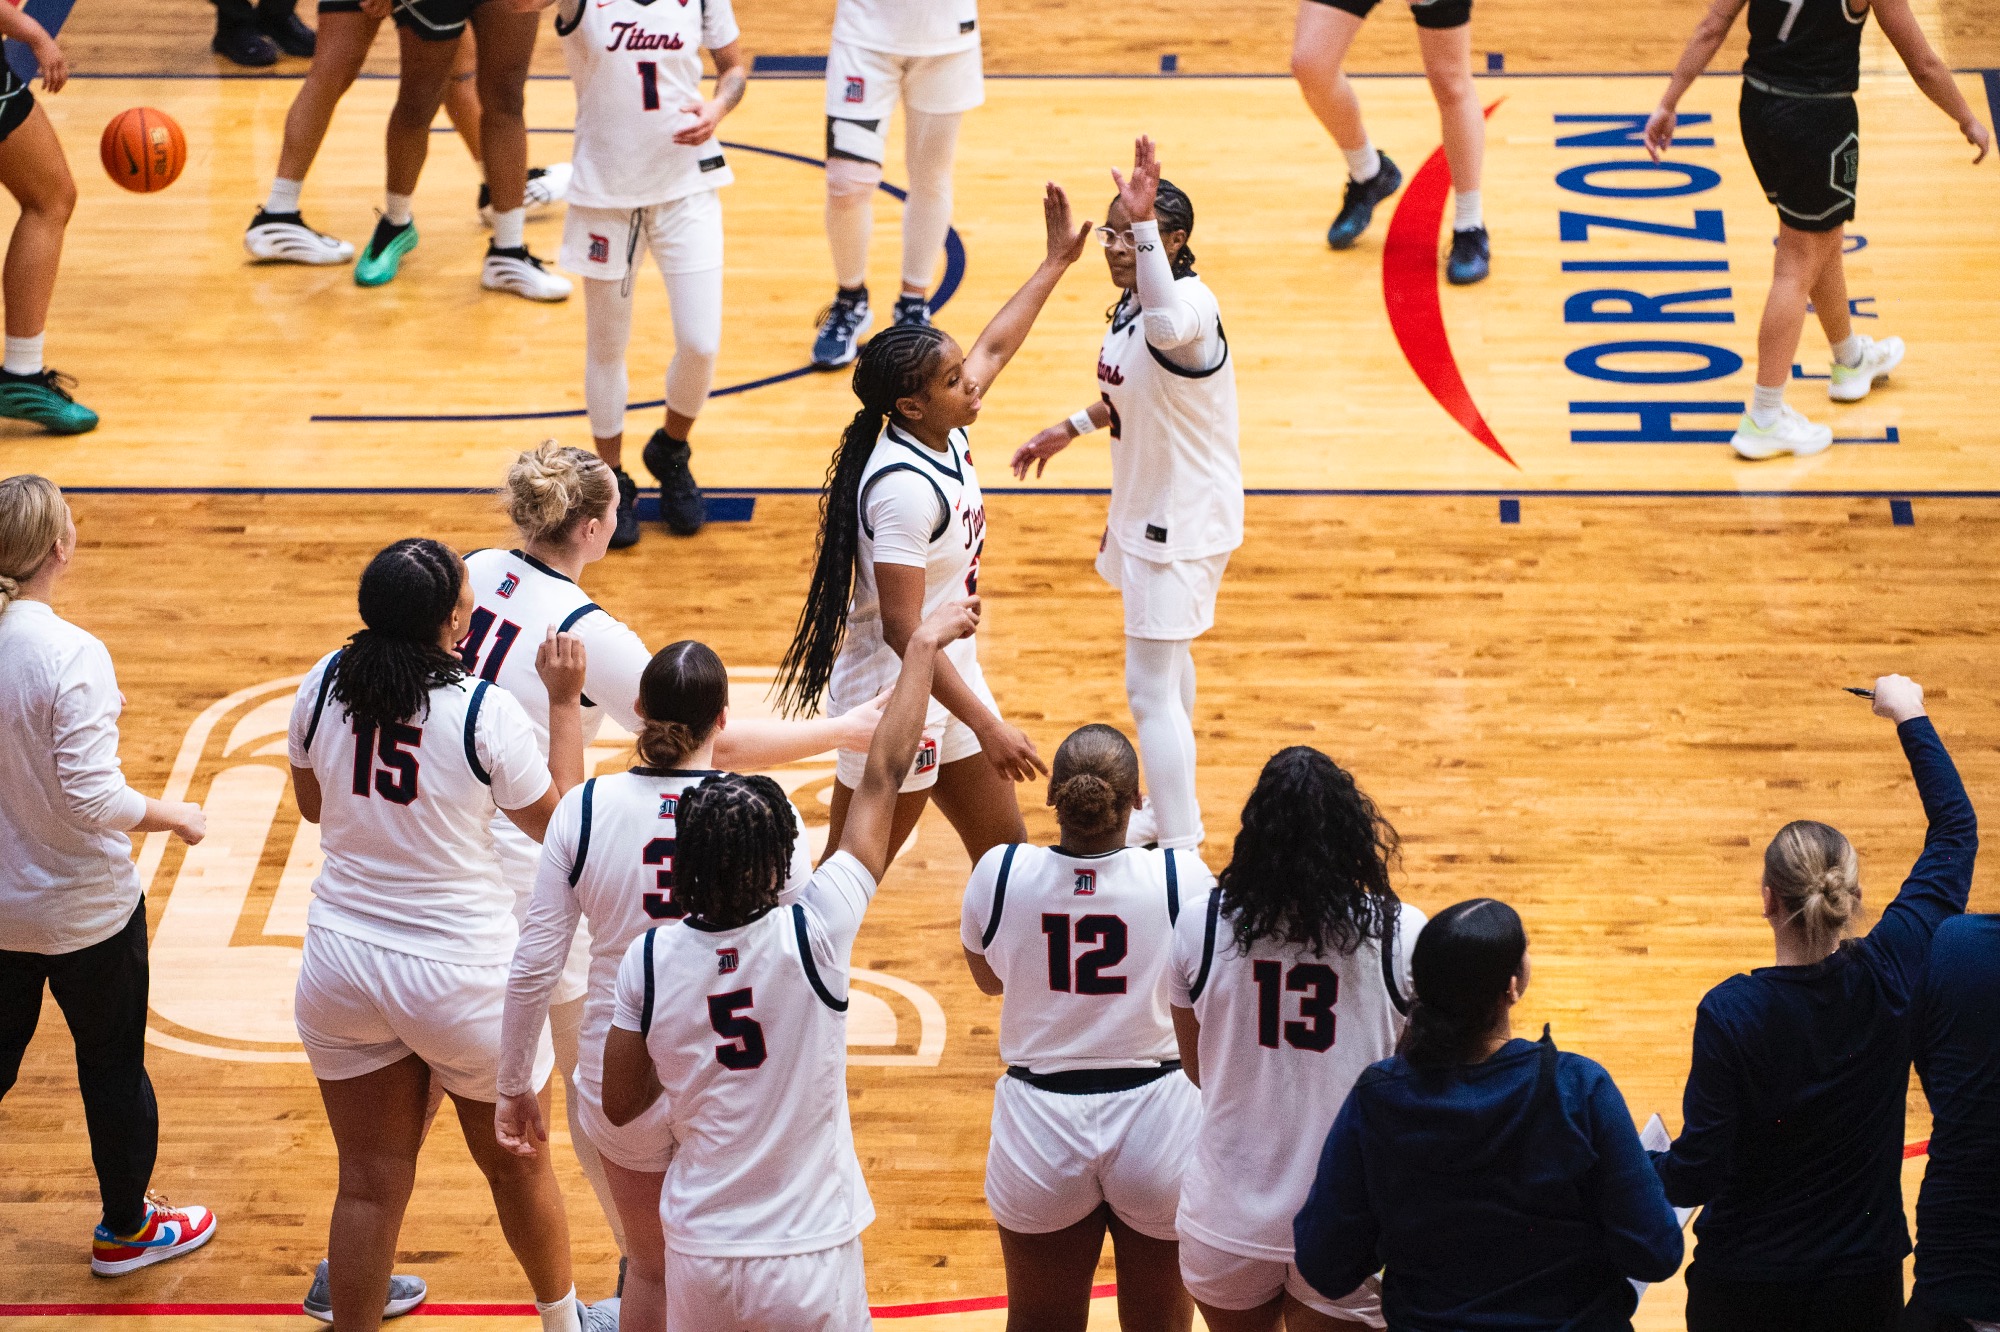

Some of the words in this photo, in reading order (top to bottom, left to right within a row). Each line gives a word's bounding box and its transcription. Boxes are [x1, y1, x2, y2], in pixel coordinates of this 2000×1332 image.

[606, 21, 684, 52] Titans
[636, 61, 660, 111] 1
[1554, 113, 1746, 444] HORIZON
[451, 605, 523, 684] 41
[352, 711, 423, 807] 15
[642, 837, 690, 920] 3
[1041, 912, 1128, 996] 12
[707, 986, 768, 1072] 5
[1253, 959, 1339, 1054] 13
